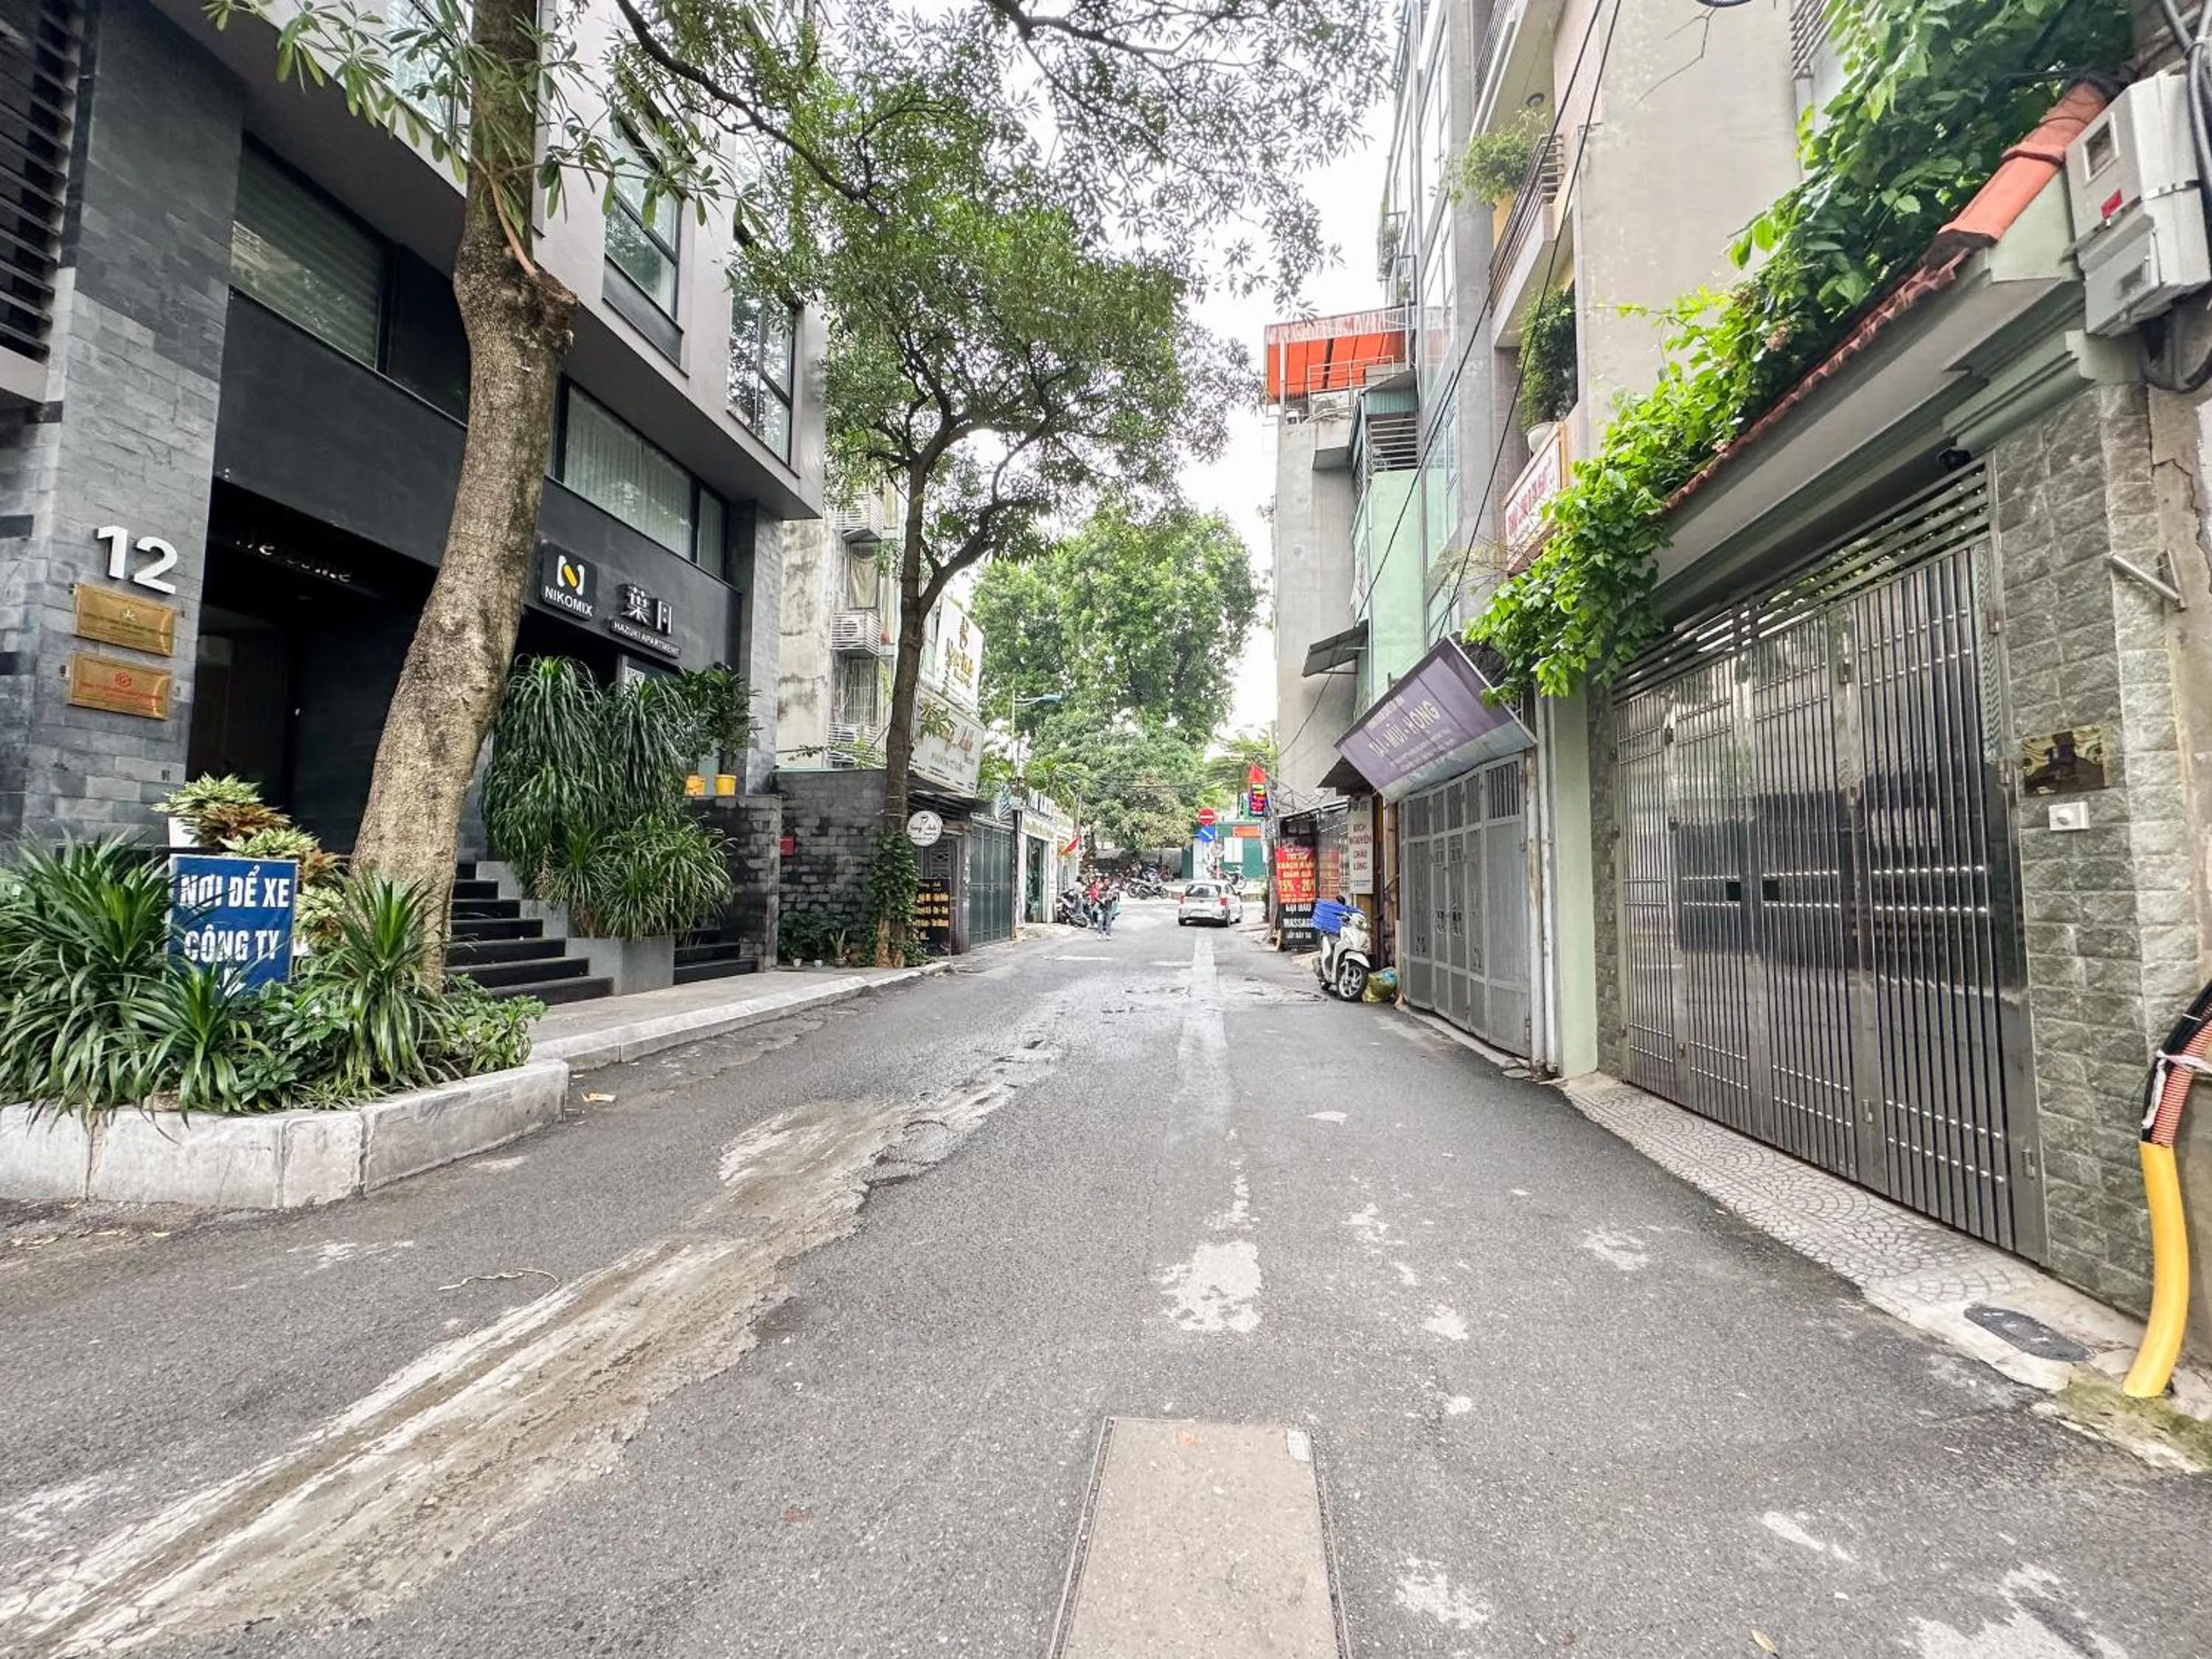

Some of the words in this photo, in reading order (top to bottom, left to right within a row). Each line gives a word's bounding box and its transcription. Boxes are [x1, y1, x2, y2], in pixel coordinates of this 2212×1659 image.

[97, 525, 178, 595] 12
[544, 585, 593, 617] NIKOMIX
[262, 877, 291, 908] XE
[184, 923, 249, 963] CÔNG
[254, 929, 281, 960] TY
